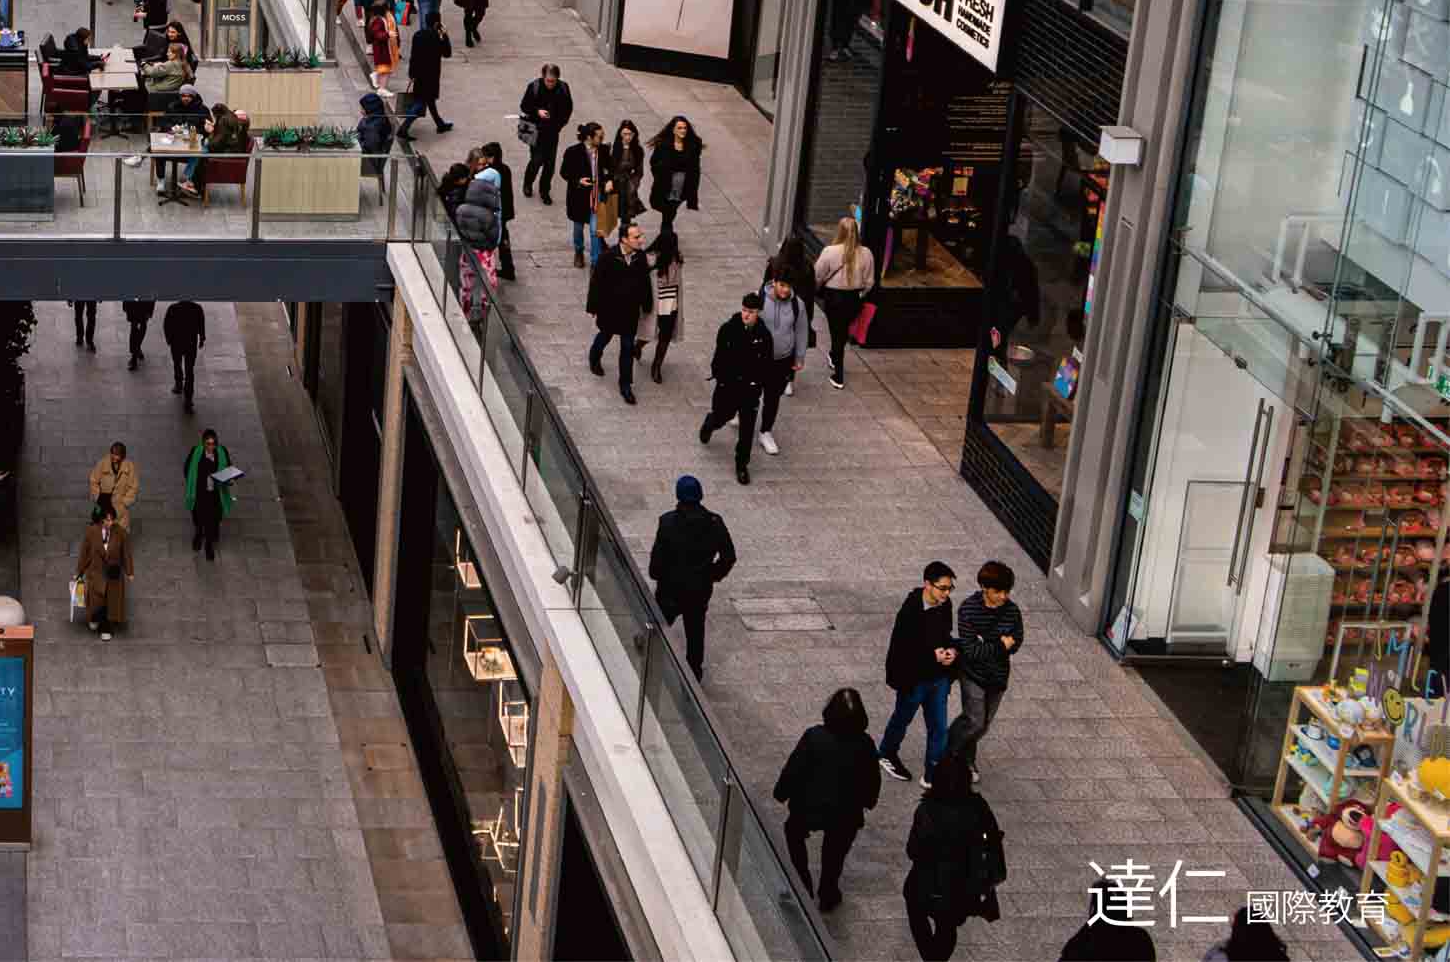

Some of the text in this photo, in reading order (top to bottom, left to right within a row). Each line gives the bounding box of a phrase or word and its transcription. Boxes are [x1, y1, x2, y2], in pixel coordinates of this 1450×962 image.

[221, 14, 246, 22] MOSS
[956, 17, 990, 50] COSMETICS
[957, 5, 991, 36] HANDMADE
